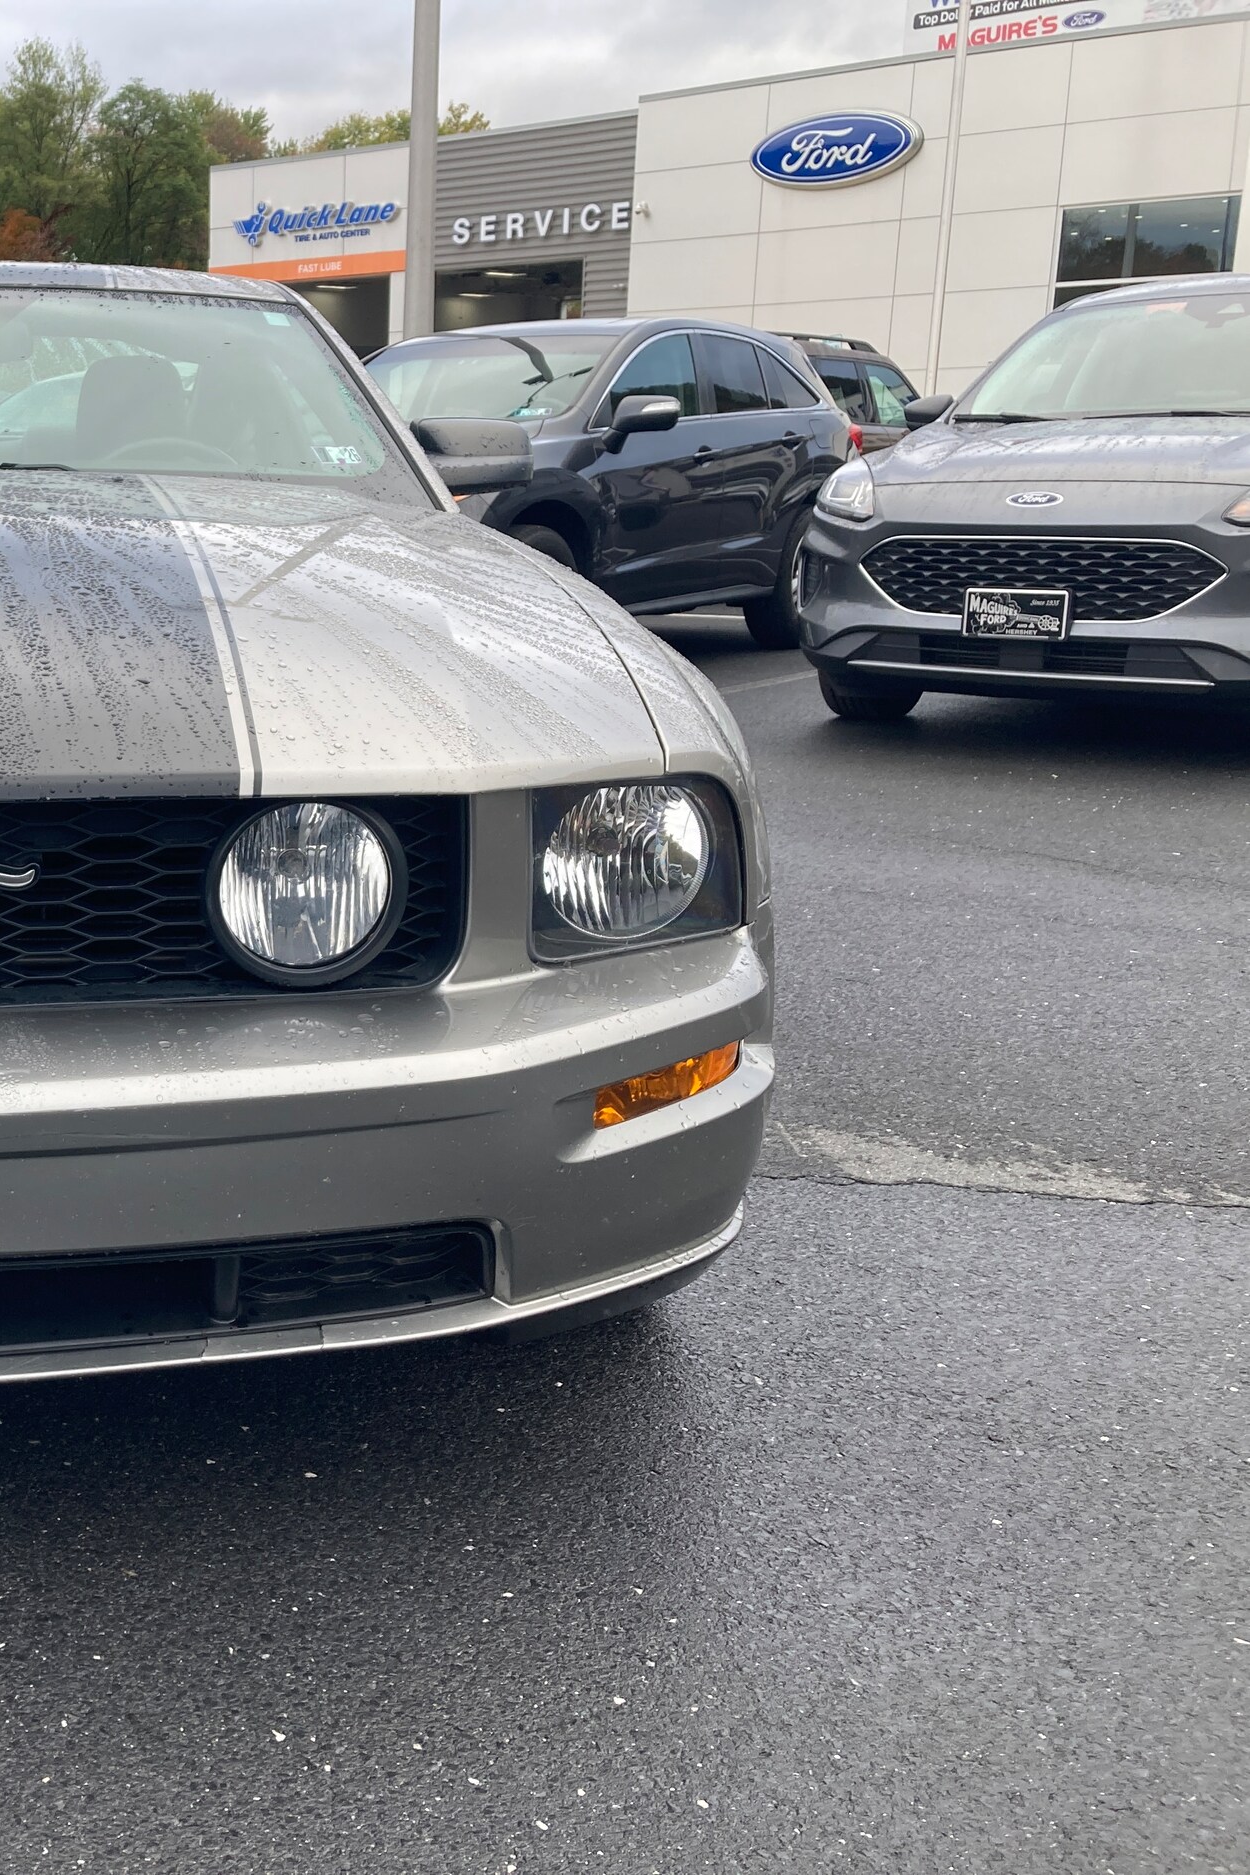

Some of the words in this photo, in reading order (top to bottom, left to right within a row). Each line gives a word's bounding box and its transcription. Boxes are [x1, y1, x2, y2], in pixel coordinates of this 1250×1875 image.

[919, 14, 938, 26] Top
[940, 8, 973, 23] Dolr
[975, 3, 1000, 17] Paid
[1002, 0, 1018, 12] for
[1069, 12, 1099, 27] Ford
[781, 127, 877, 173] Ford
[268, 203, 332, 234] Quick
[335, 201, 396, 227] Lane
[452, 201, 631, 245] SERVICE
[294, 234, 311, 243] TIRE
[319, 231, 339, 240] AUTO
[340, 228, 370, 239] CENTER
[298, 263, 318, 274] FAST
[320, 261, 342, 271] LUBE
[980, 613, 1007, 626] FORD
